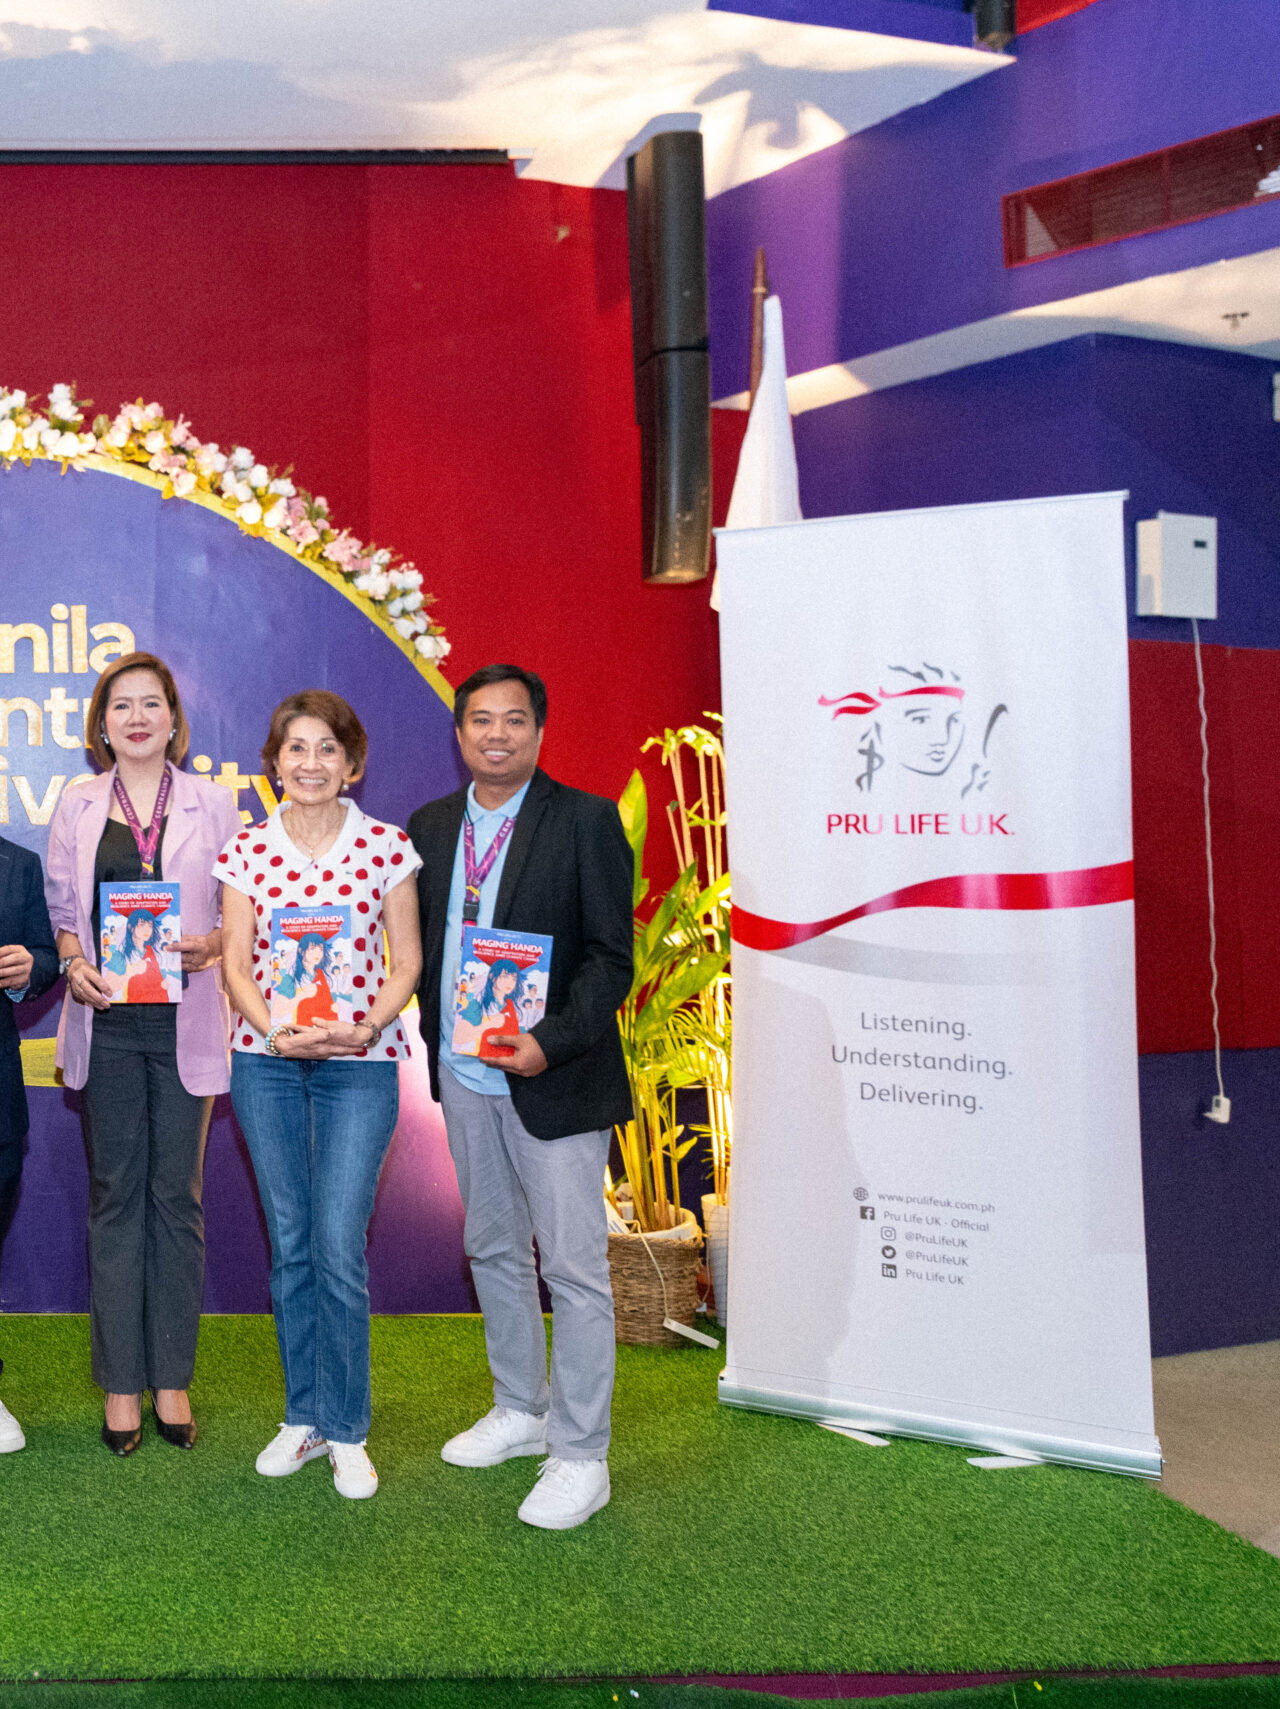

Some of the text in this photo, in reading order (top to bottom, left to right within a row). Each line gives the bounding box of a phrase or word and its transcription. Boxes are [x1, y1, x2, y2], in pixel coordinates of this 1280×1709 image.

[827, 813, 1015, 835] PRU LIFE U.K.
[109, 892, 174, 900] MAGING HANDA
[280, 915, 345, 925] MAGING HANDA
[472, 937, 509, 950] MAGING
[510, 942, 544, 954] HANDA
[860, 1012, 972, 1040] Listening.
[831, 1044, 1013, 1080] Understanding.
[860, 1082, 984, 1114] Delivering.
[877, 1191, 996, 1213] www.prulifeuk.com.ph
[883, 1210, 900, 1222] Pru
[903, 1213, 923, 1224] Life
[925, 1216, 941, 1226] UK
[951, 1218, 990, 1232] Official
[904, 1231, 968, 1248] @PruLifeUK
[905, 1249, 969, 1267] @PruLifeUK
[906, 1268, 964, 1285] Pru Life UK
